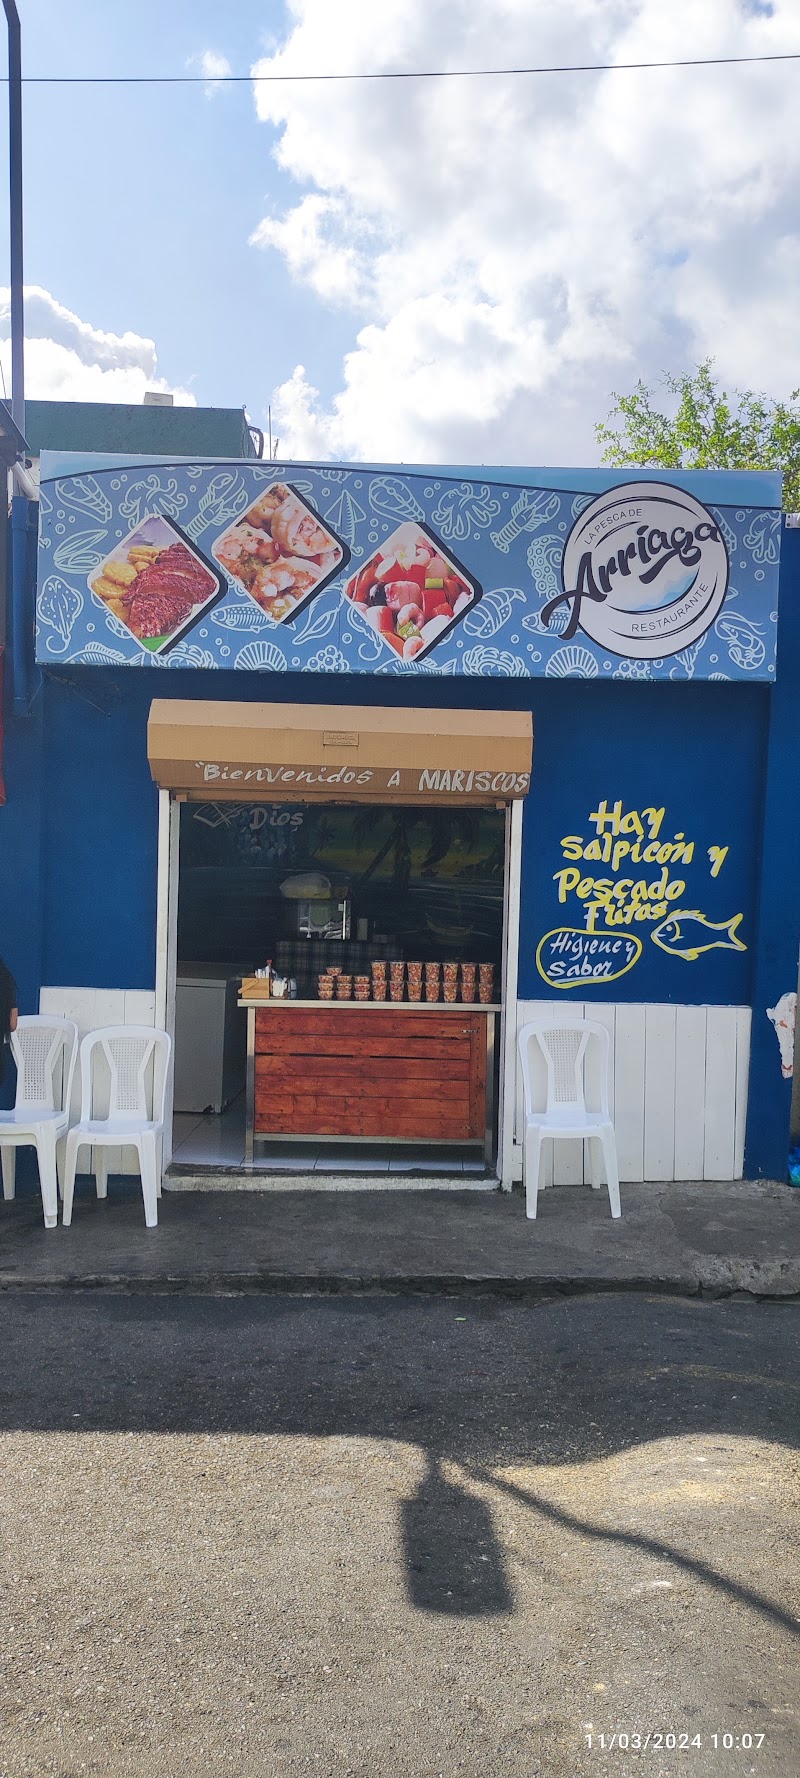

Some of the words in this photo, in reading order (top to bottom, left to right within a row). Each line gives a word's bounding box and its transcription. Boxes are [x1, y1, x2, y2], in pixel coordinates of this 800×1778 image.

[583, 532, 597, 545] LA
[594, 511, 627, 533] PESCA
[628, 508, 643, 517] DE
[540, 522, 721, 640] Arriaga
[631, 582, 709, 633] RESTAURANTE
[387, 769, 401, 788] A
[418, 768, 530, 793] MARISCOS
[249, 806, 304, 830] Dios
[588, 800, 666, 840] Hay
[552, 866, 686, 903] Pescado
